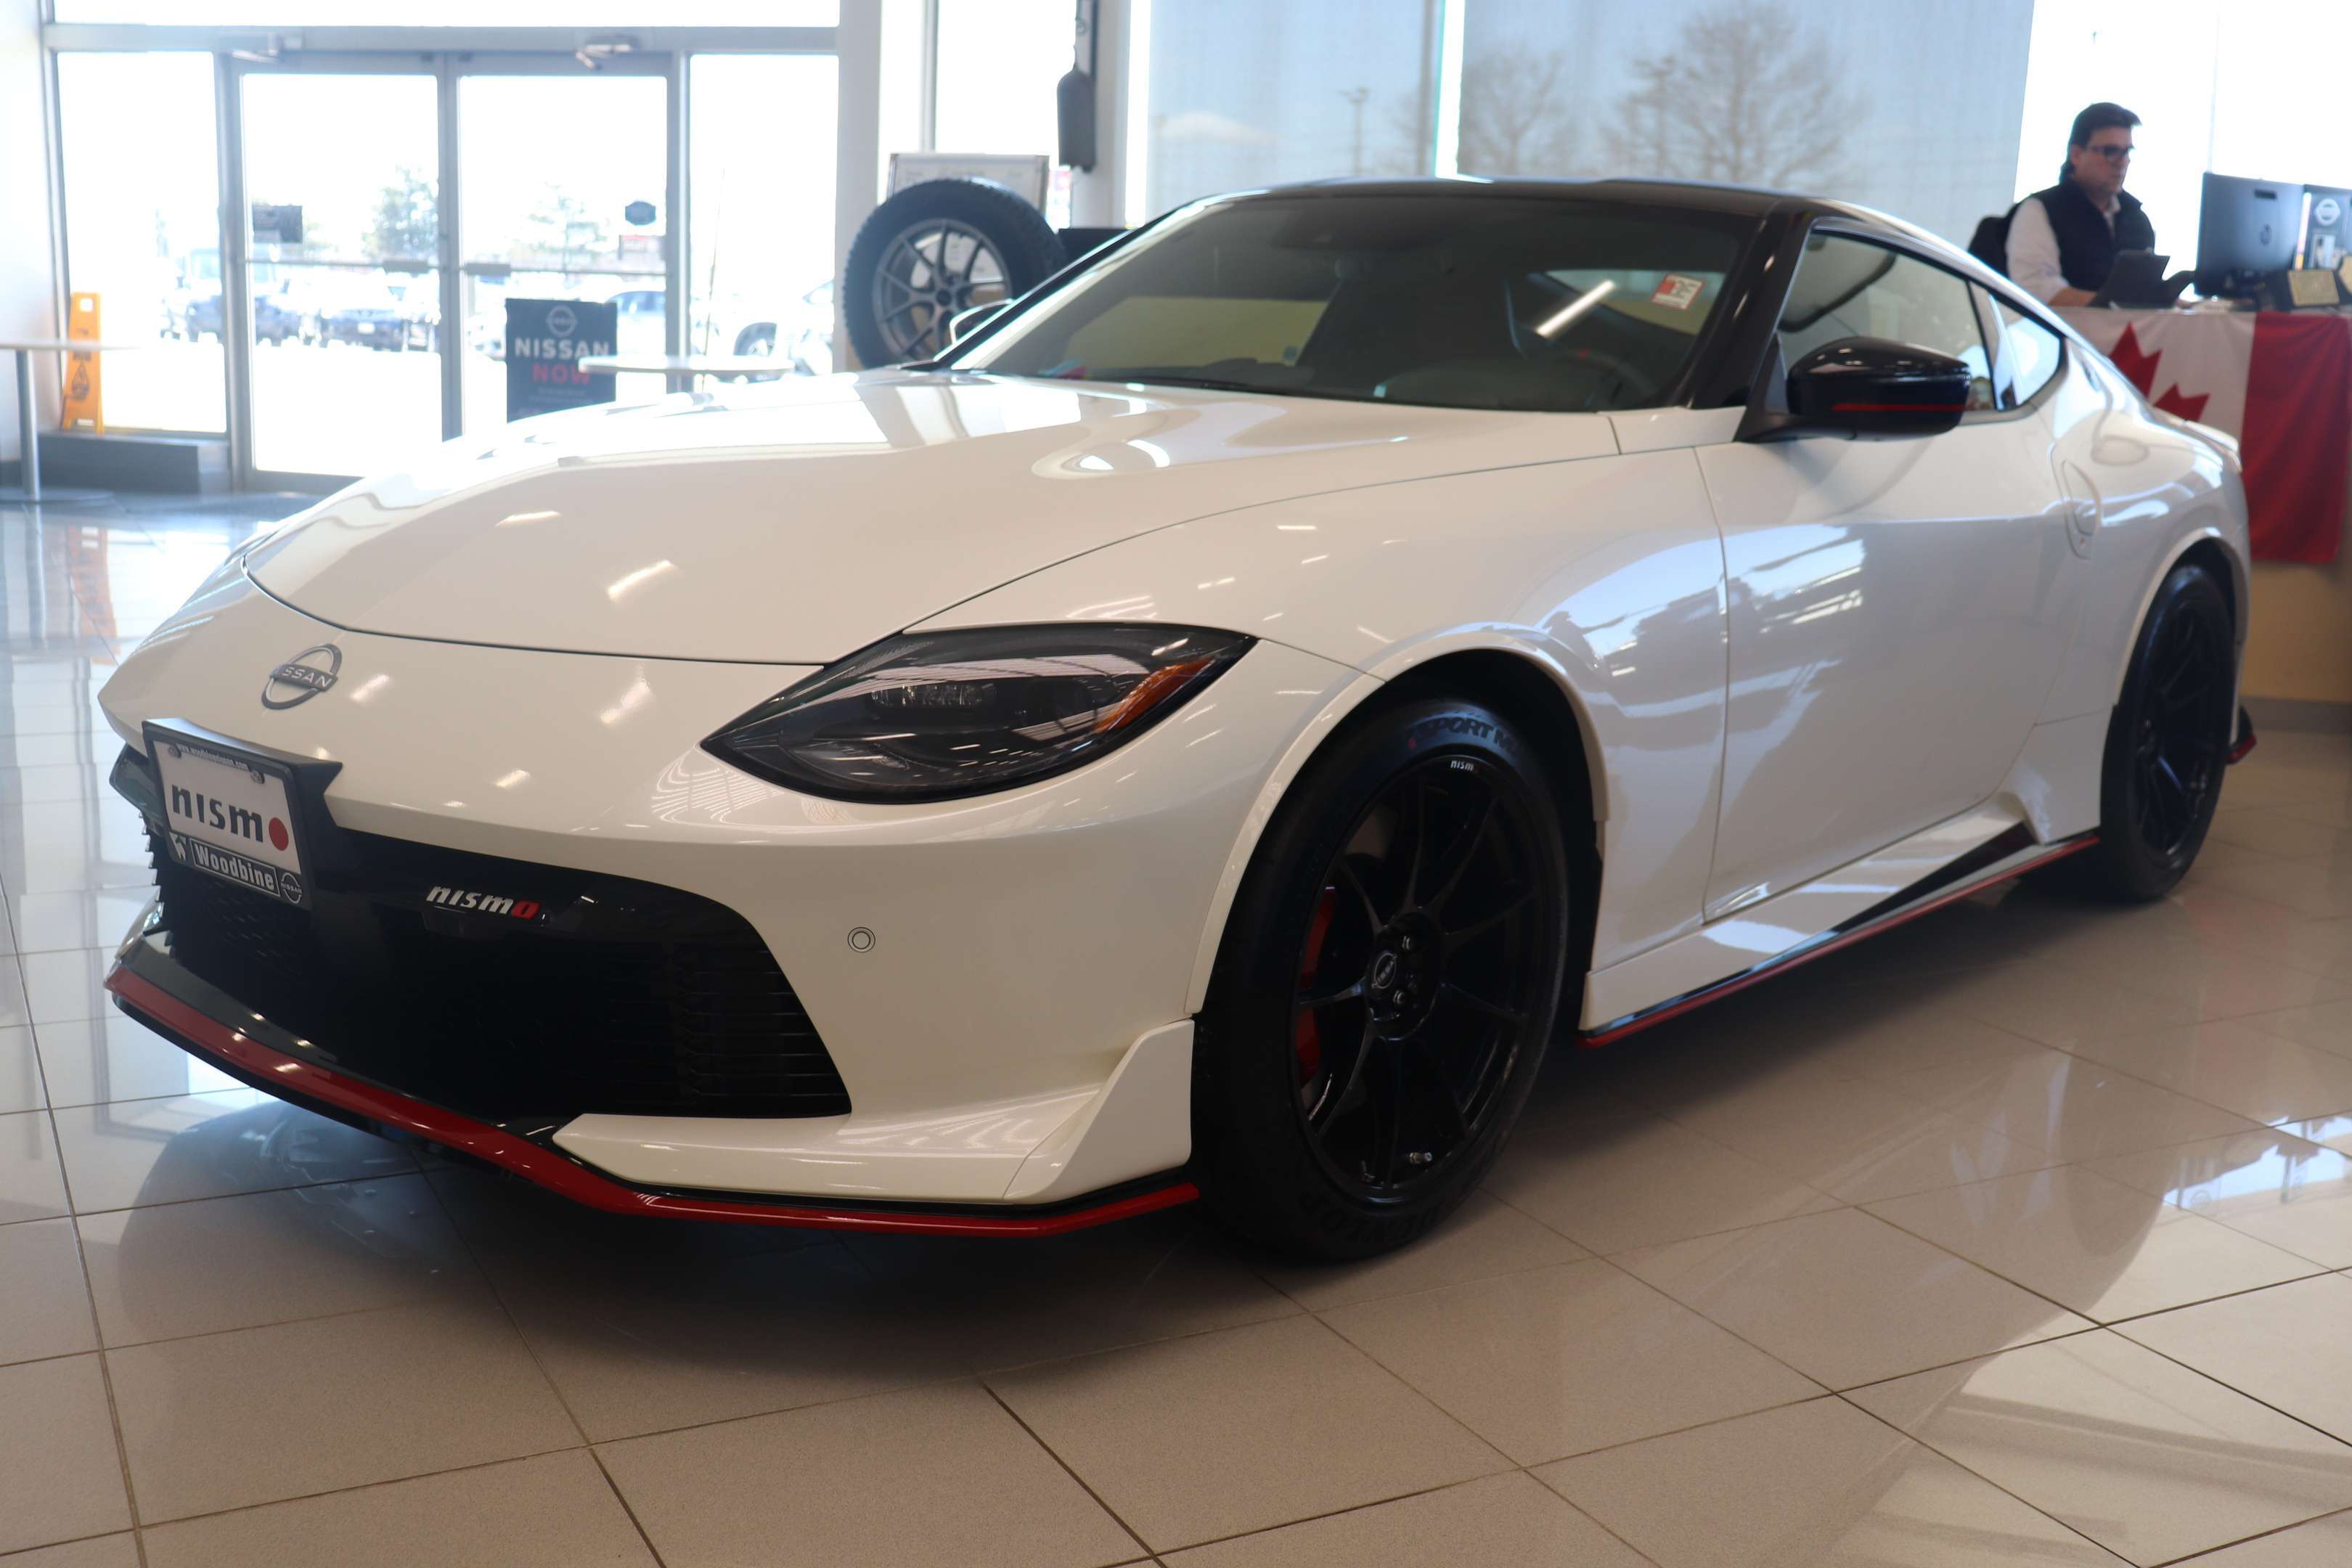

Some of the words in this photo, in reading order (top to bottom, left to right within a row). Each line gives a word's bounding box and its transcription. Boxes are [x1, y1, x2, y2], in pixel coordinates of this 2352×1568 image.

[515, 337, 609, 360] NISSAN
[195, 843, 275, 891] Woodbine
[425, 886, 541, 920] nismo
